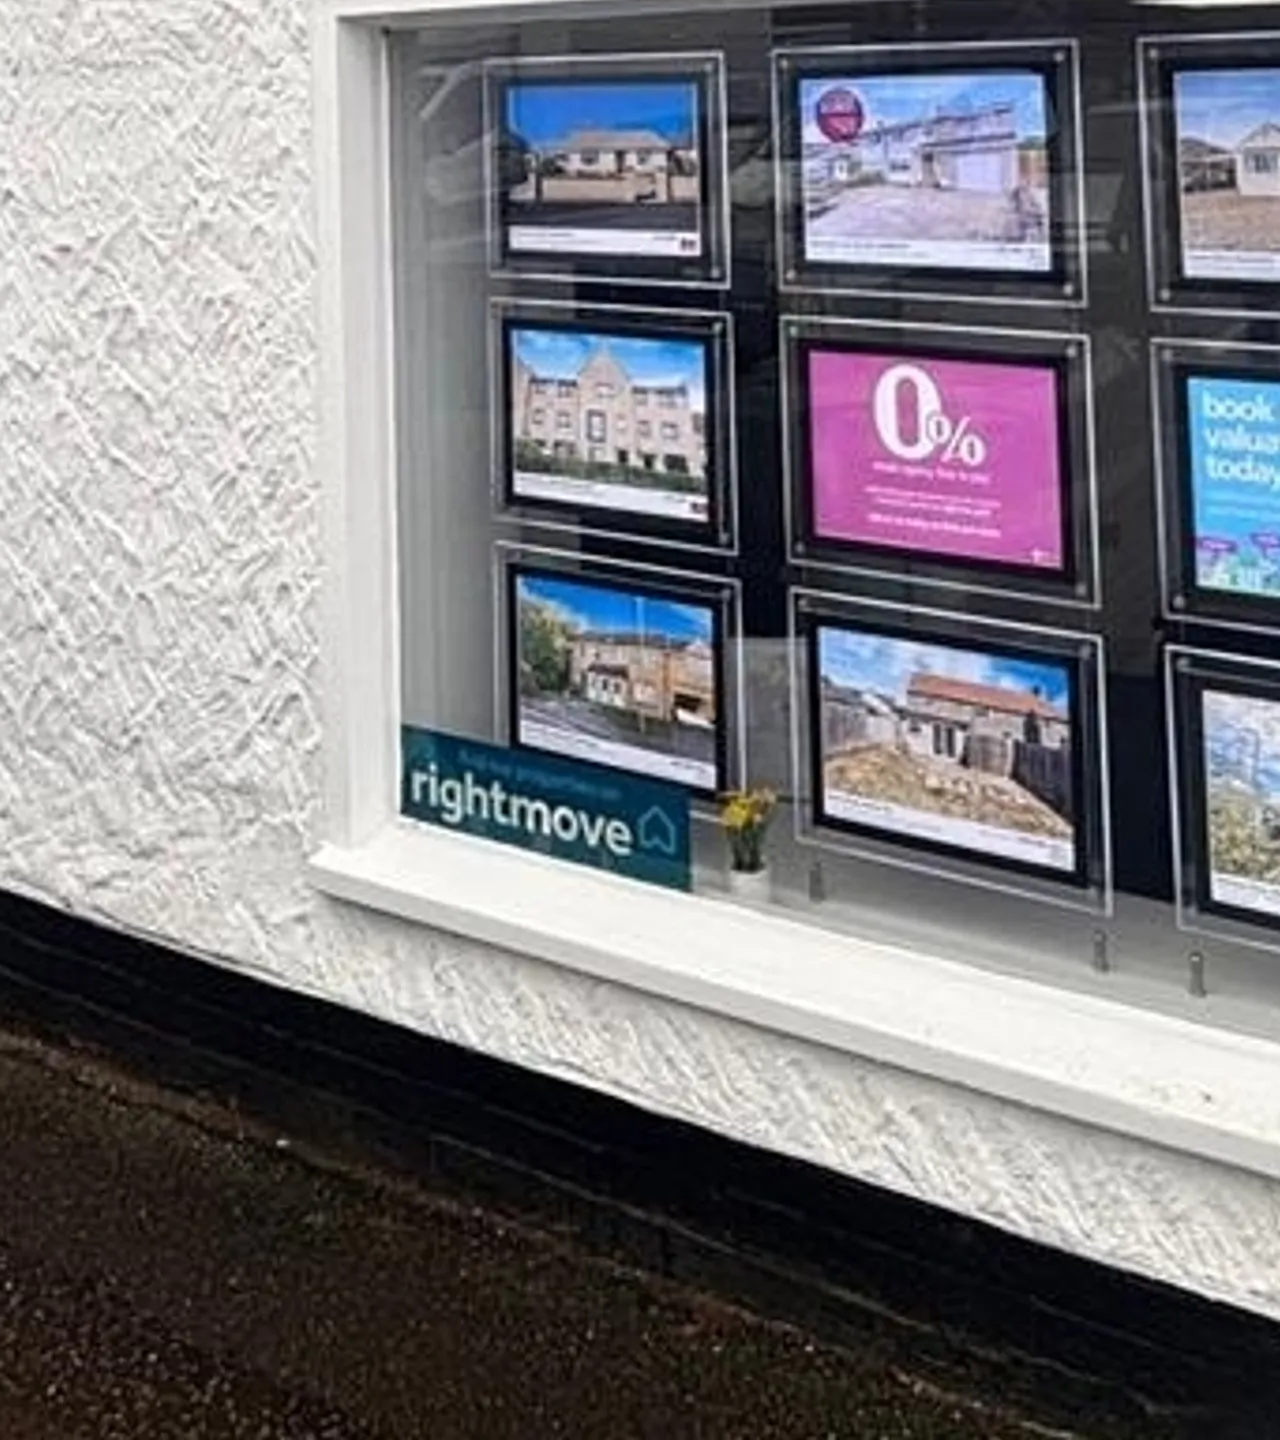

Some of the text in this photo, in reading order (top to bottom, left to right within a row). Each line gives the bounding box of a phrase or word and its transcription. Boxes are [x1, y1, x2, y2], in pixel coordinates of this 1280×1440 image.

[874, 363, 987, 467] 0%
[1203, 390, 1275, 422] book
[410, 762, 633, 855] rightmove
